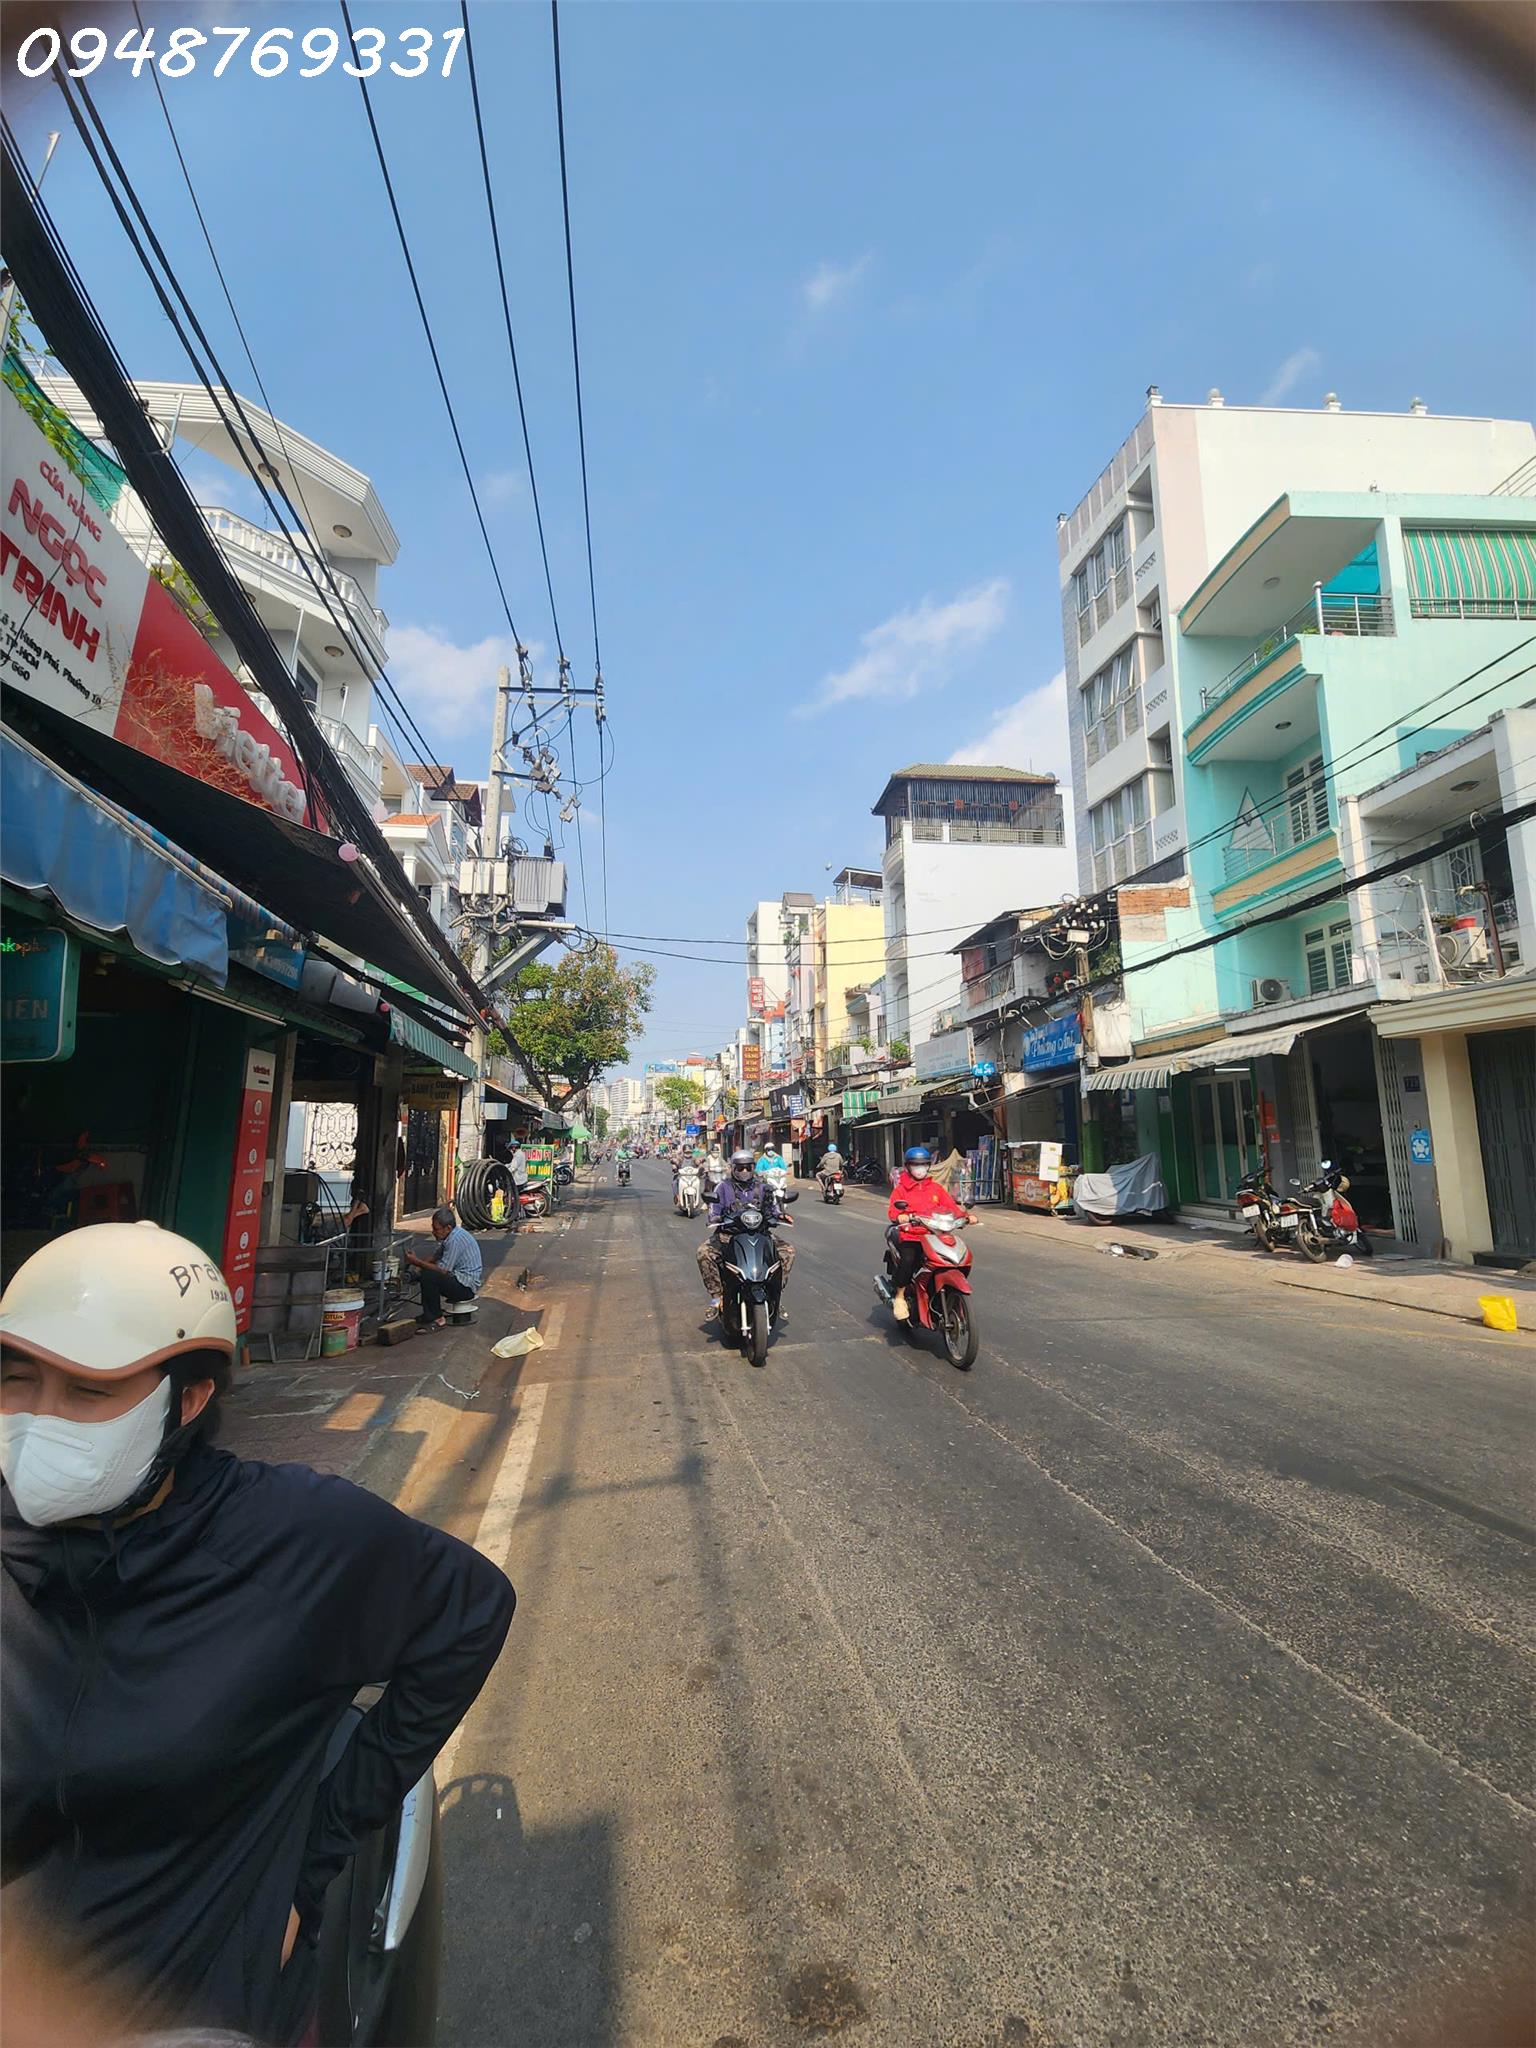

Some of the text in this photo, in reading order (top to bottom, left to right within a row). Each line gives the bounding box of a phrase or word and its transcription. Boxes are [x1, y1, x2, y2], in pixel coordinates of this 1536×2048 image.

[8, 479, 107, 609] NGỌC
[67, 493, 102, 542] HÀNG
[0, 530, 101, 663] TRINH
